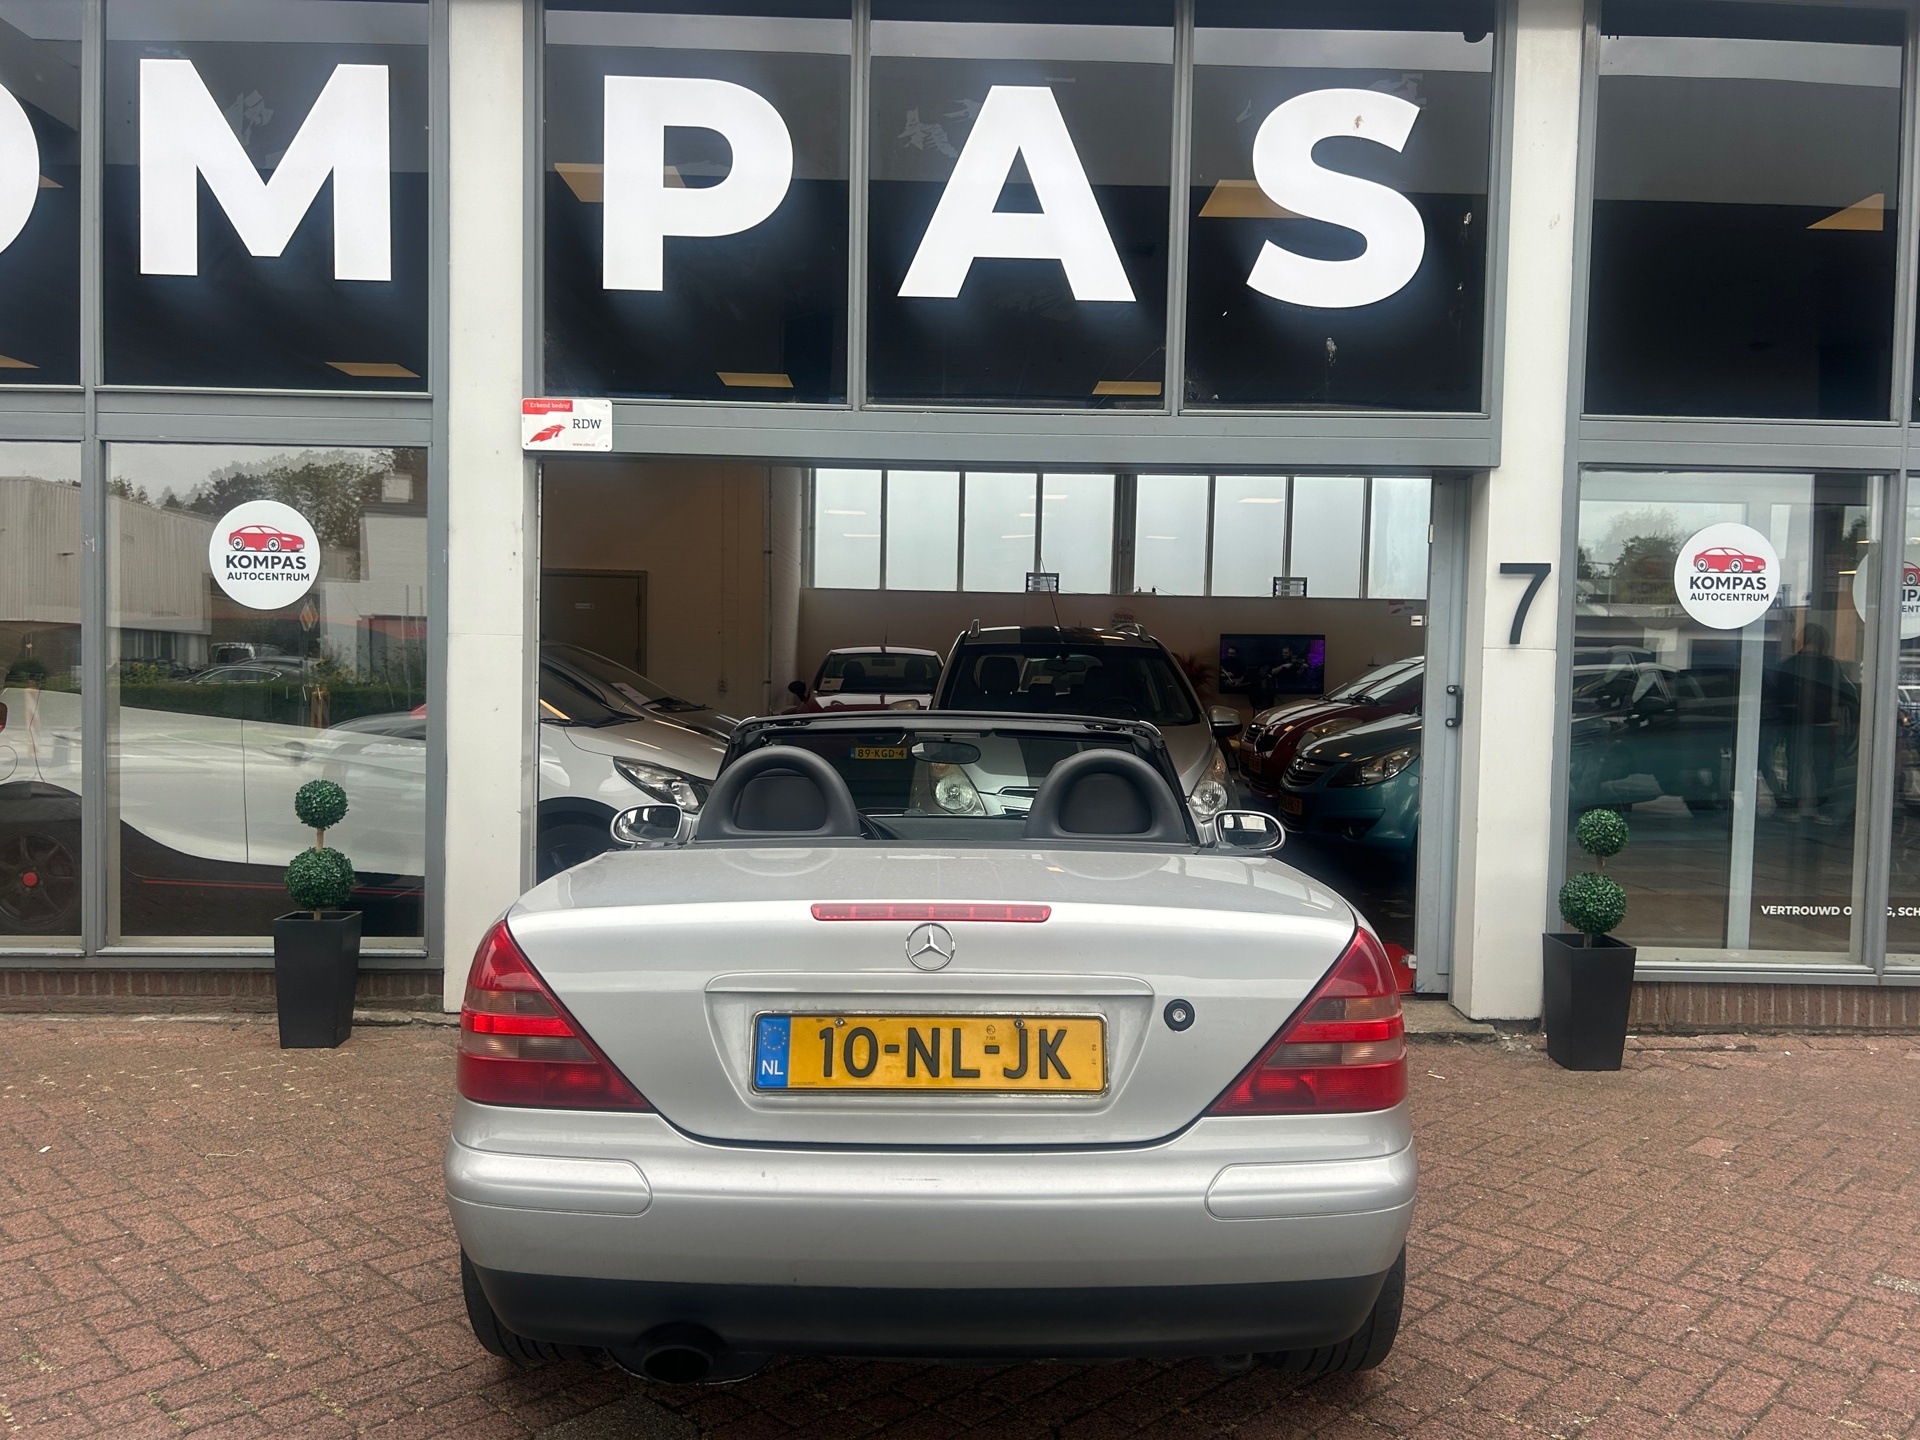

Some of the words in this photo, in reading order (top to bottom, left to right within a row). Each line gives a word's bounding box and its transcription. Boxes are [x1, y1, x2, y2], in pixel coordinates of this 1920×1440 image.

[572, 418, 602, 429] RDW
[226, 555, 307, 570] KOMPAS
[227, 572, 310, 581] AUTOCENTRUM
[1689, 576, 1767, 590] KOMPAS
[1690, 592, 1769, 602] AUTOCENTRUM
[1500, 562, 1551, 645] 7
[857, 748, 904, 758] 89-KGD-4
[1761, 905, 1840, 915] VERTROUWD
[818, 1027, 1072, 1080] 10-NL-JK
[762, 1060, 784, 1076] NL
